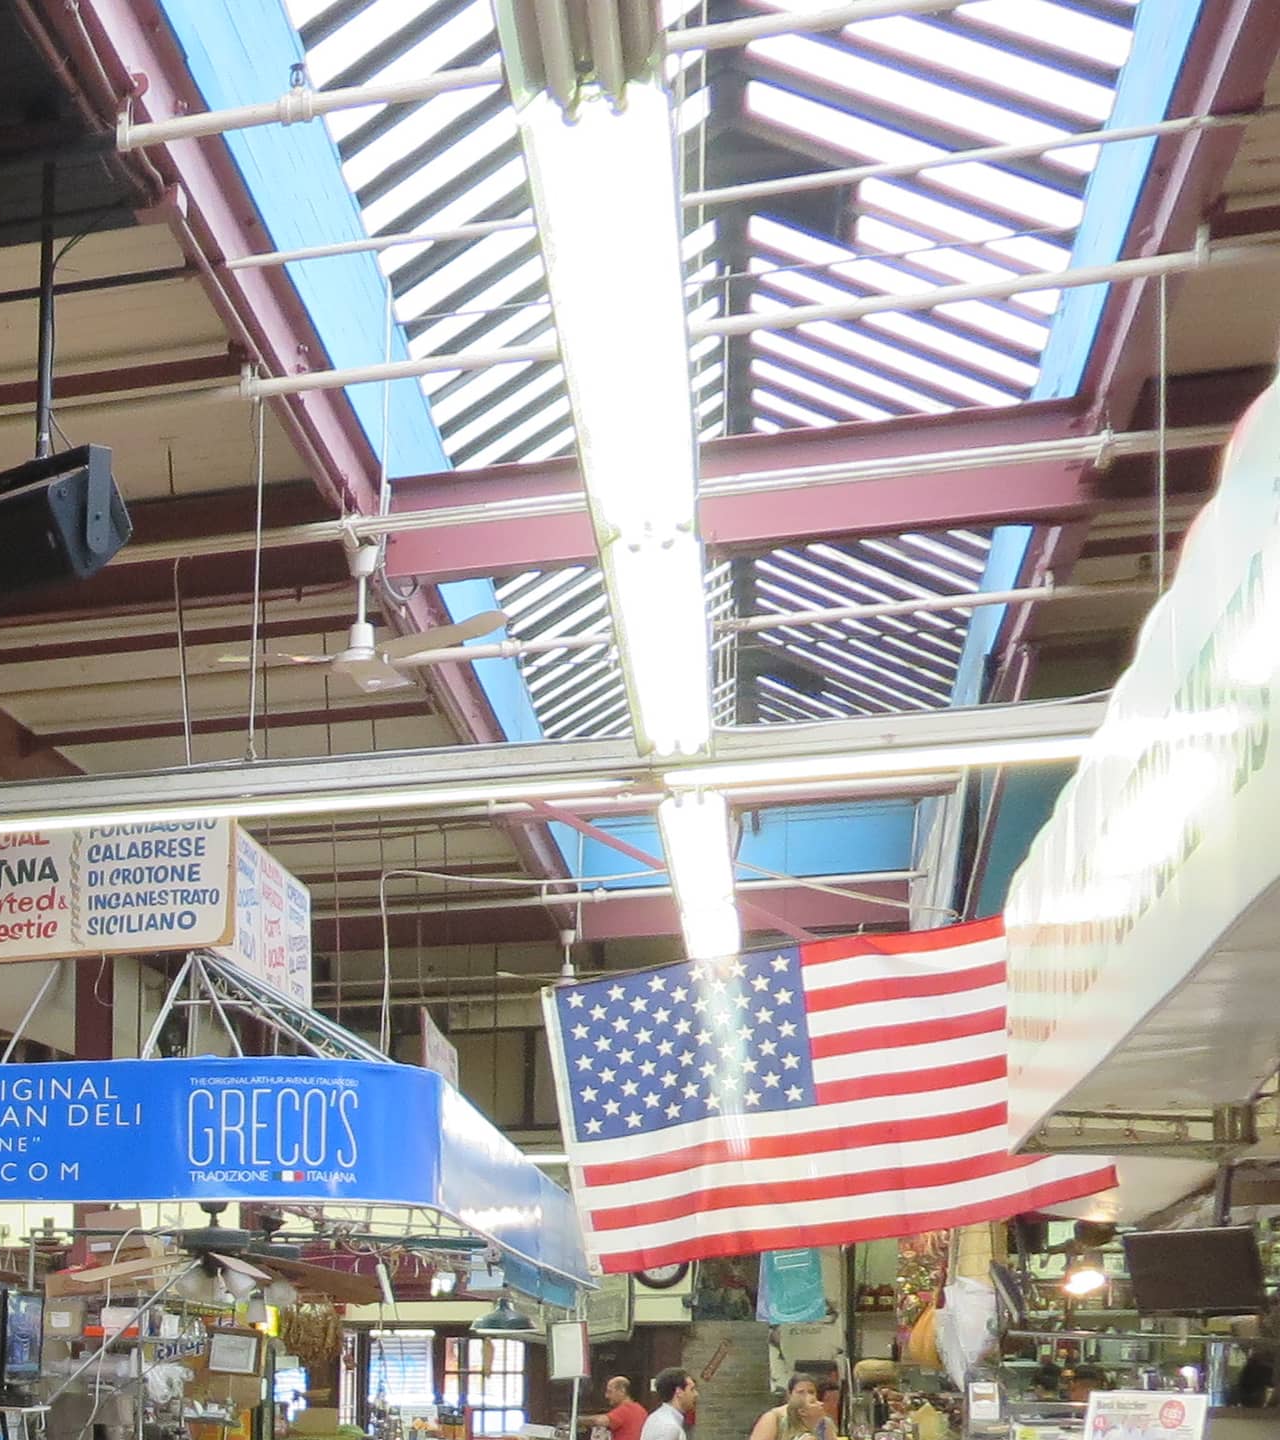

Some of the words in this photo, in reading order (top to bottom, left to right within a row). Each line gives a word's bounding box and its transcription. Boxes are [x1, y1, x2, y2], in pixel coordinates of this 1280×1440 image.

[90, 819, 218, 838] FORMAGGIO
[88, 837, 206, 864] CALABRESE
[88, 871, 104, 887] DI
[109, 864, 201, 886] CROTONE
[58, 899, 70, 910] &
[87, 911, 197, 935] SICILIANO
[68, 1103, 141, 1126] DELI
[188, 1088, 359, 1168] GRECO'S
[190, 1170, 269, 1183] TRADIZIONE
[307, 1170, 357, 1184] ITALIANA
